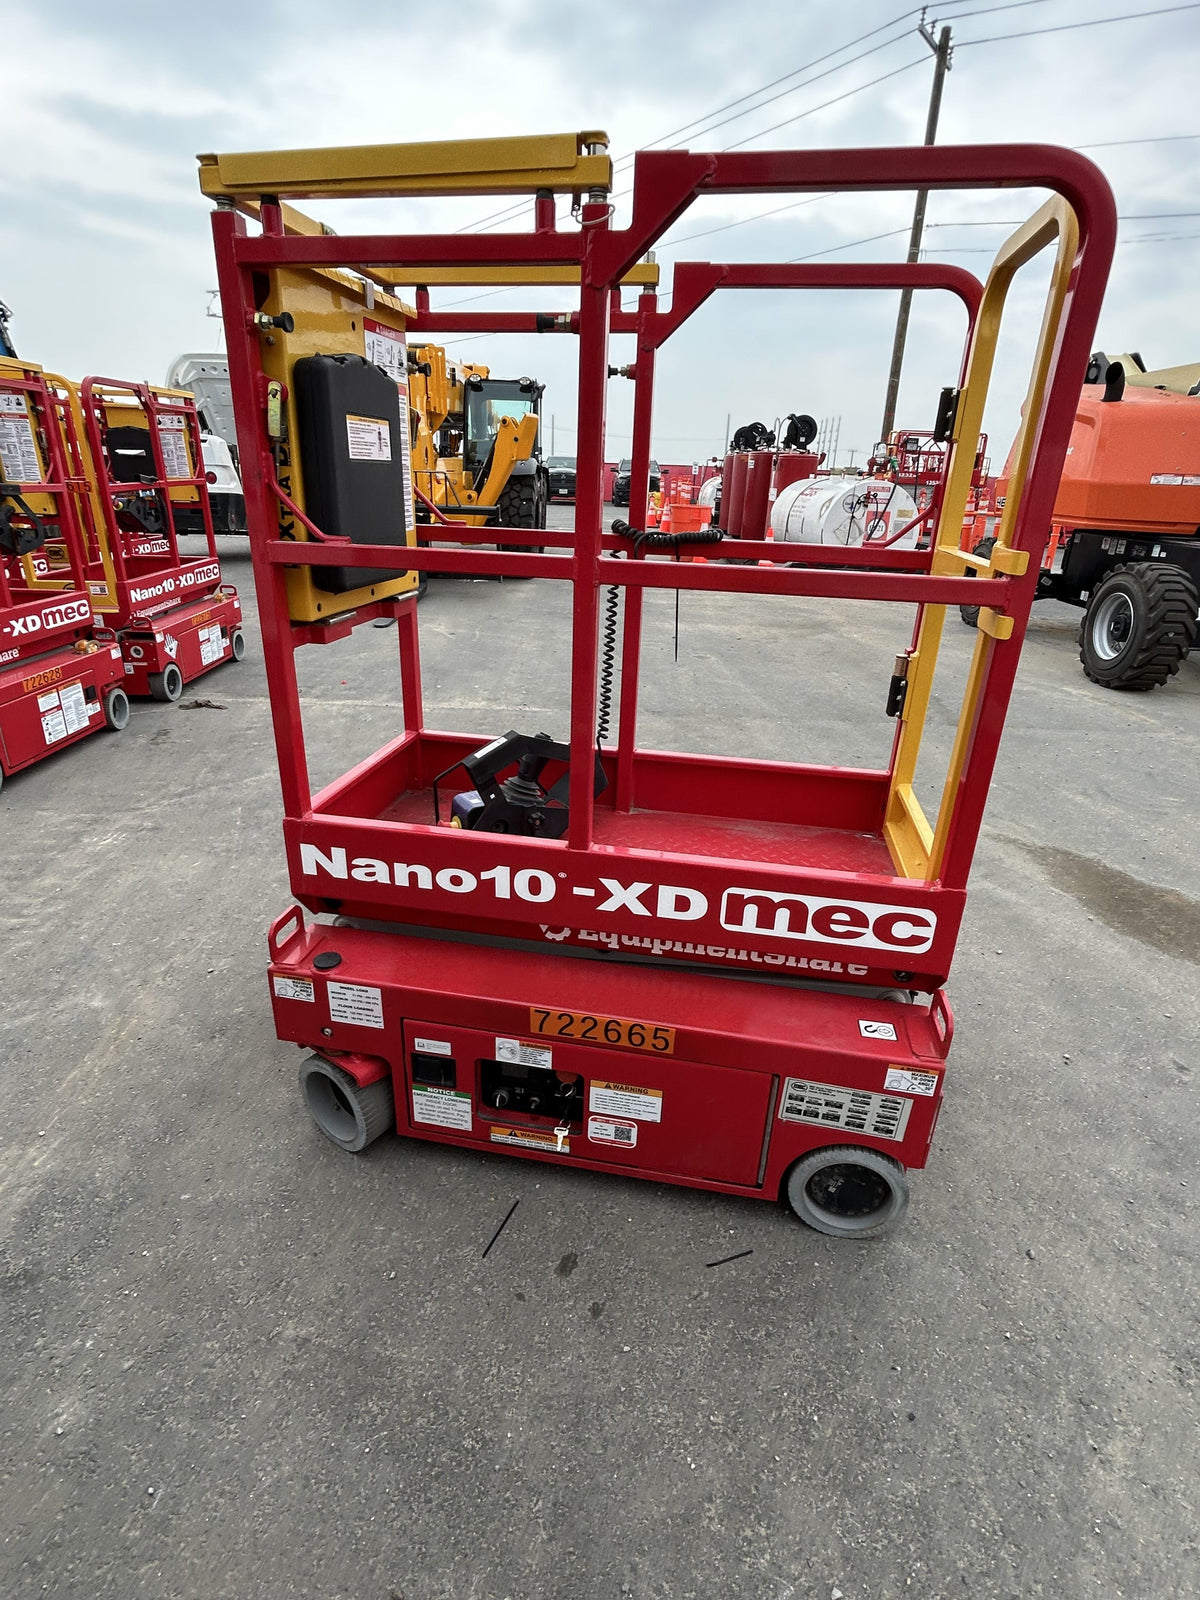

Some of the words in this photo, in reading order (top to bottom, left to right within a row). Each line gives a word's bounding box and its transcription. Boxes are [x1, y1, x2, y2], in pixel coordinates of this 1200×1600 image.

[196, 566, 218, 583] mec
[43, 603, 89, 626] mec
[23, 667, 61, 691] 722628
[724, 892, 933, 947] mec
[534, 1009, 670, 1051] 722665
[427, 1087, 455, 1097] NOTICE
[613, 1083, 649, 1095] WARNING
[413, 1091, 444, 1101] EMERGENCY
[445, 1097, 471, 1105] LOWERING
[520, 1131, 553, 1142] WARNING
